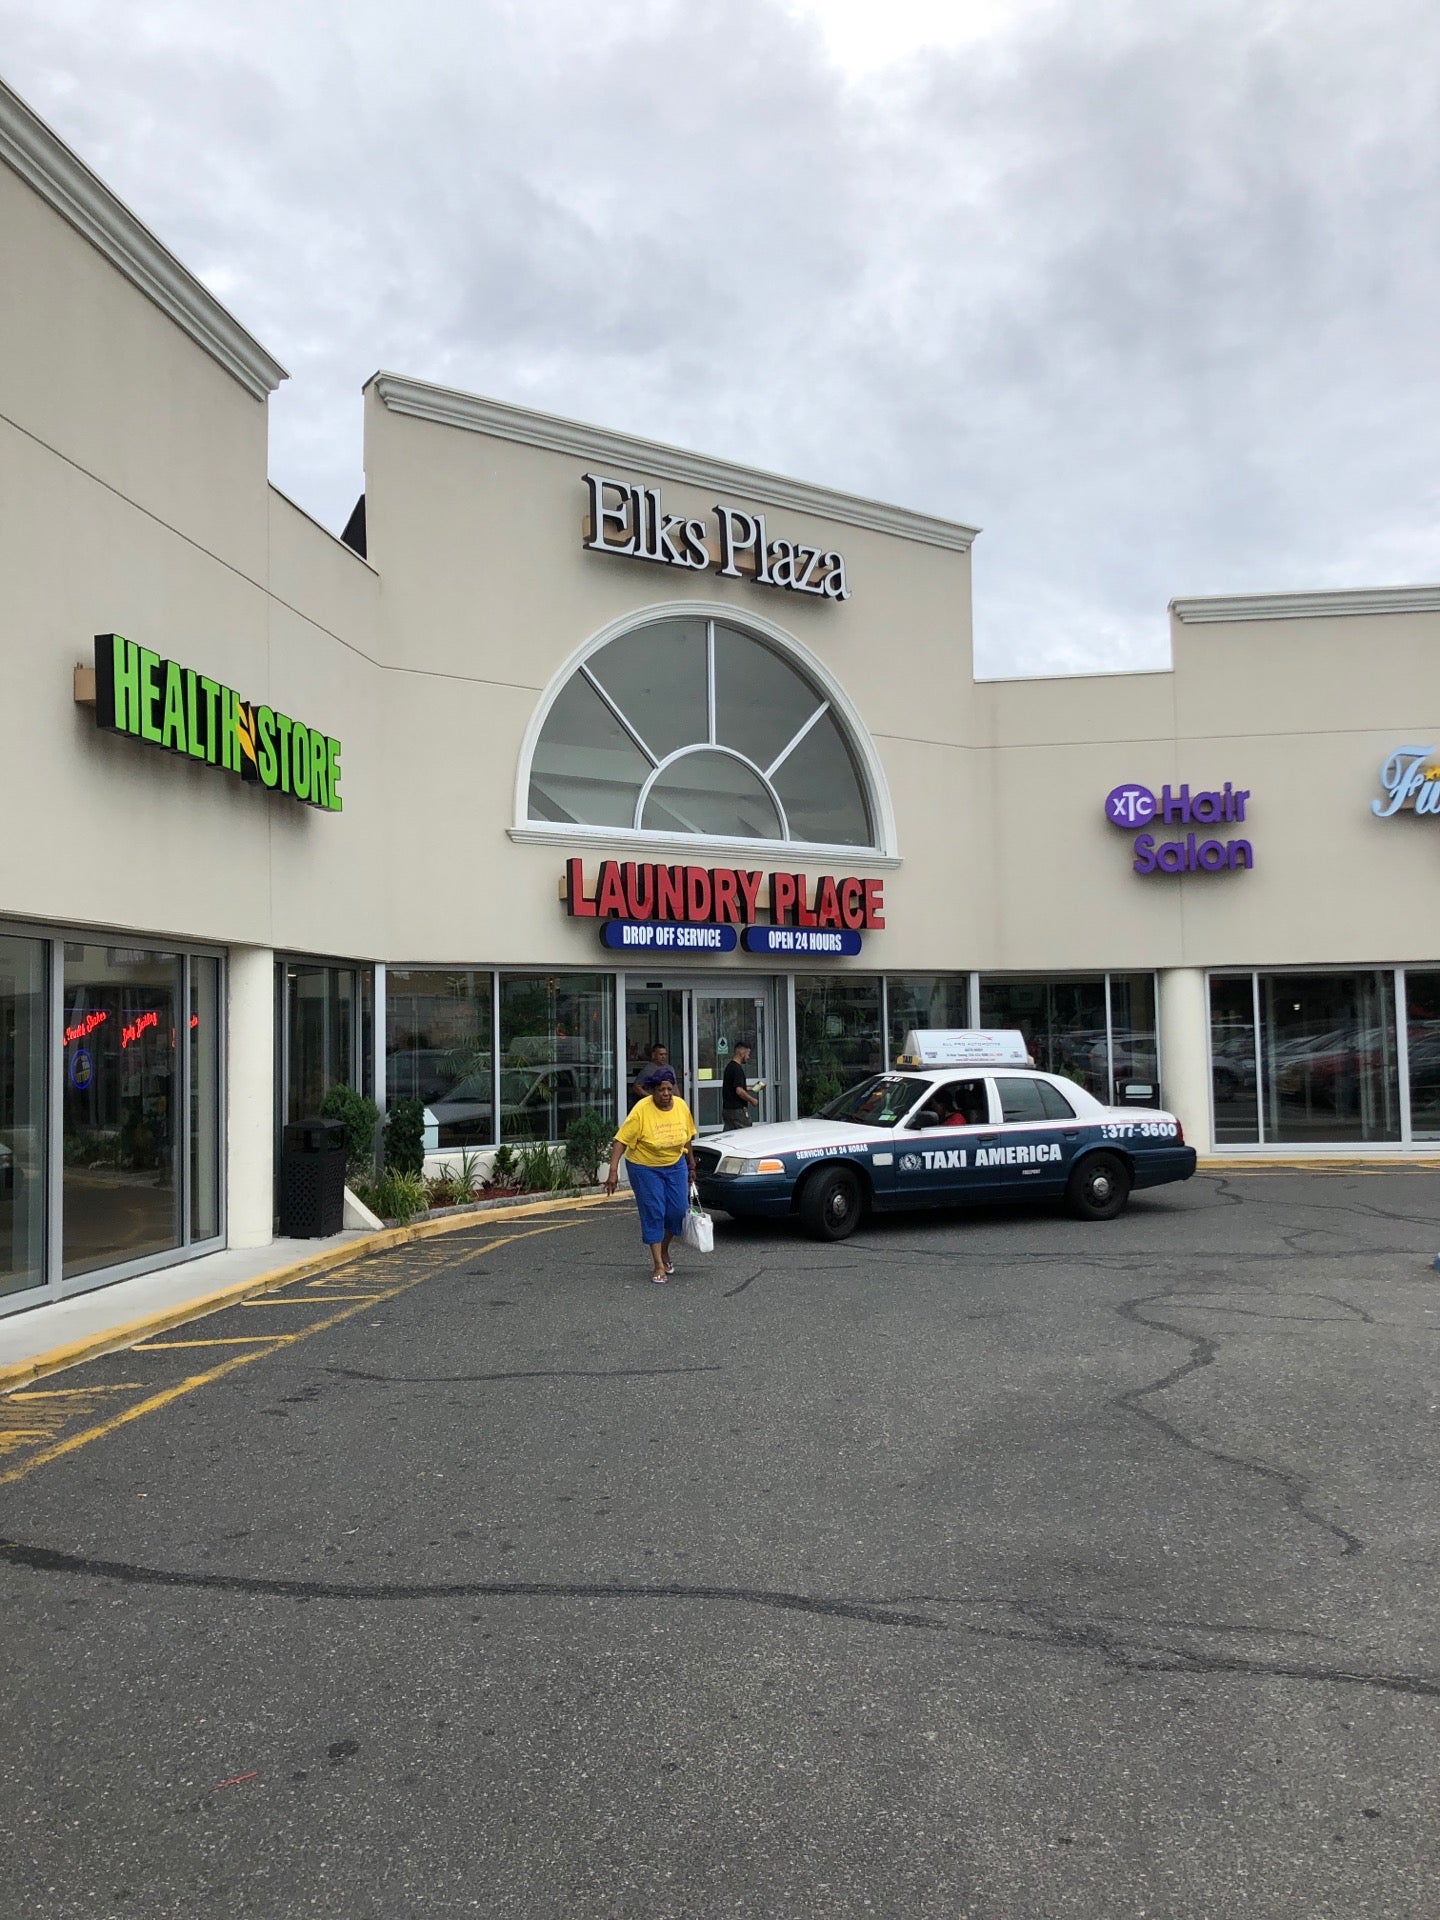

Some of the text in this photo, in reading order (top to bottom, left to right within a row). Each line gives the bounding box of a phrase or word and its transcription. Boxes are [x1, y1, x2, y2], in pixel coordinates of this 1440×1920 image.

[581, 472, 853, 602] Elks Plaza
[95, 633, 343, 812] HEALTH STORE
[1162, 782, 1251, 825] Hair
[1133, 832, 1254, 875] Salon
[566, 858, 886, 930] LAUNDRY PLACE
[622, 925, 721, 948] DROP OFF SERVICE
[768, 931, 842, 951] OPEN 24 HOURS
[902, 1055, 913, 1064] TAXI
[795, 1143, 869, 1160] SERVICIO LAS 24 HORAS
[921, 1143, 1063, 1170] TAXI AMERICA
